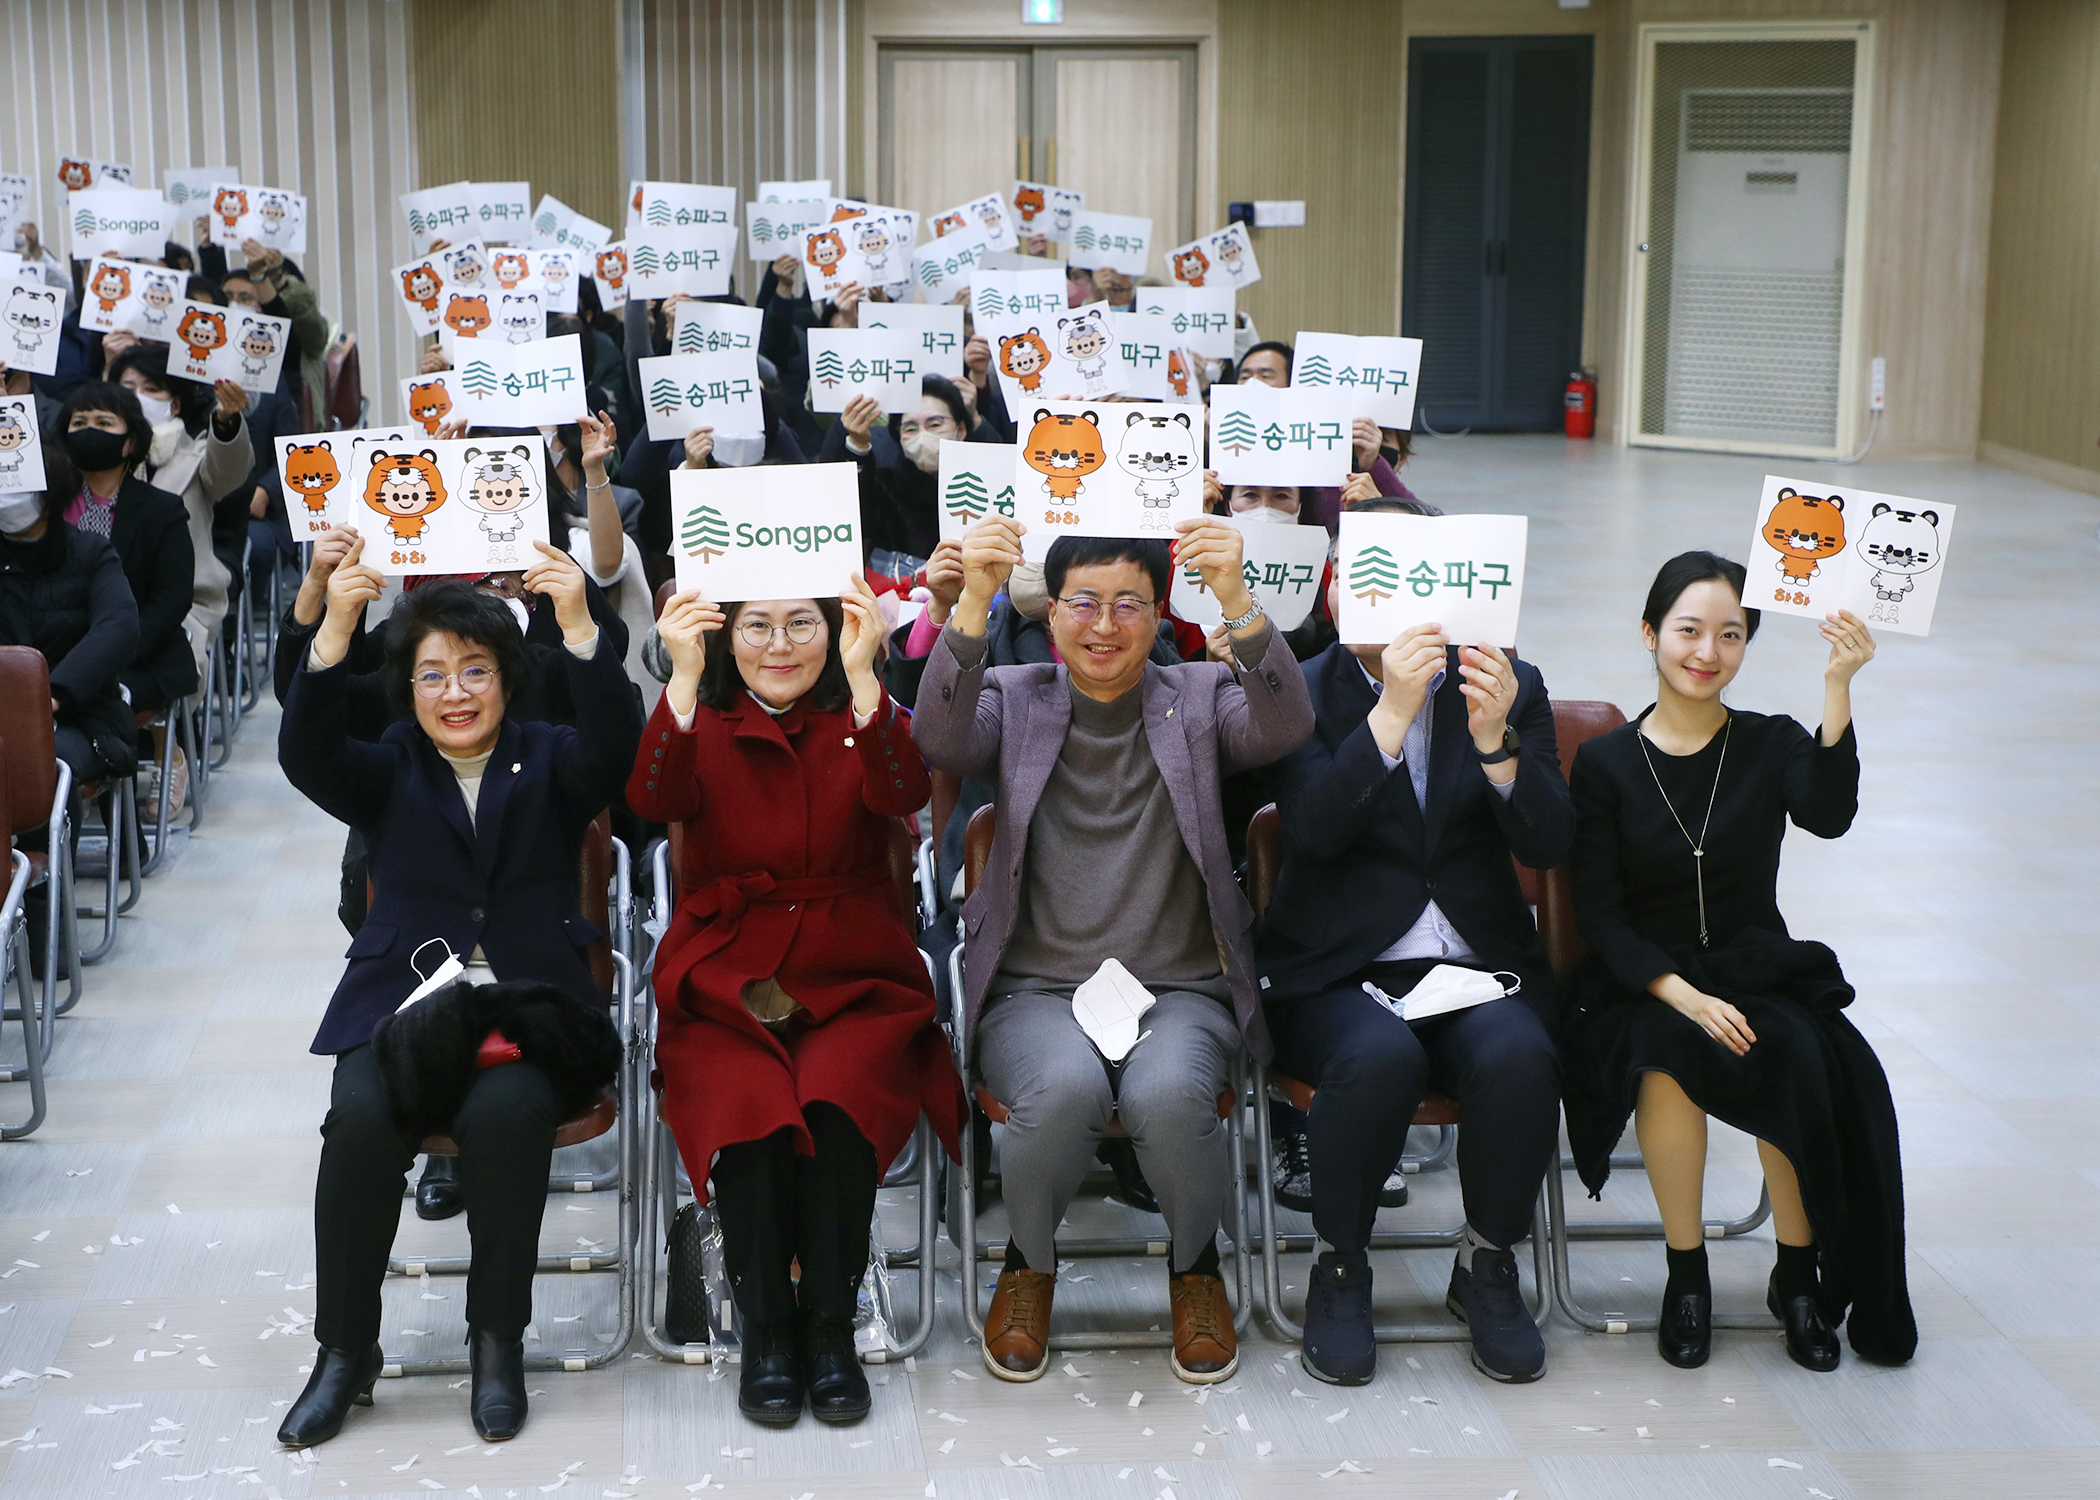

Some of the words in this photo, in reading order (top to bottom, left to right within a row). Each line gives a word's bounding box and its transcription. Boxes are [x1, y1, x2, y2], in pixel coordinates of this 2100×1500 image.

[426, 206, 470, 230] 송파구
[479, 203, 524, 221] 송파구
[99, 217, 159, 235] Songpa
[776, 223, 820, 240] 송파
[556, 228, 597, 255] 송파구
[1099, 234, 1143, 254] 송파구
[662, 249, 720, 272] 송파구
[1007, 294, 1061, 314] 송파구
[1171, 312, 1229, 333] 송파구
[706, 330, 752, 352] 송파구
[922, 331, 957, 354] 파구
[1120, 343, 1162, 368] 파구
[501, 366, 575, 397] 송파구
[847, 358, 915, 383] 송파구
[685, 379, 753, 407] 송파구
[1261, 421, 1344, 451] 송파구
[308, 521, 331, 532] 하하
[1044, 510, 1080, 528] 하하
[736, 522, 852, 553] Songpa
[390, 550, 427, 567] 하하
[1405, 560, 1512, 600] 송파구
[1773, 587, 1811, 609] 하하
